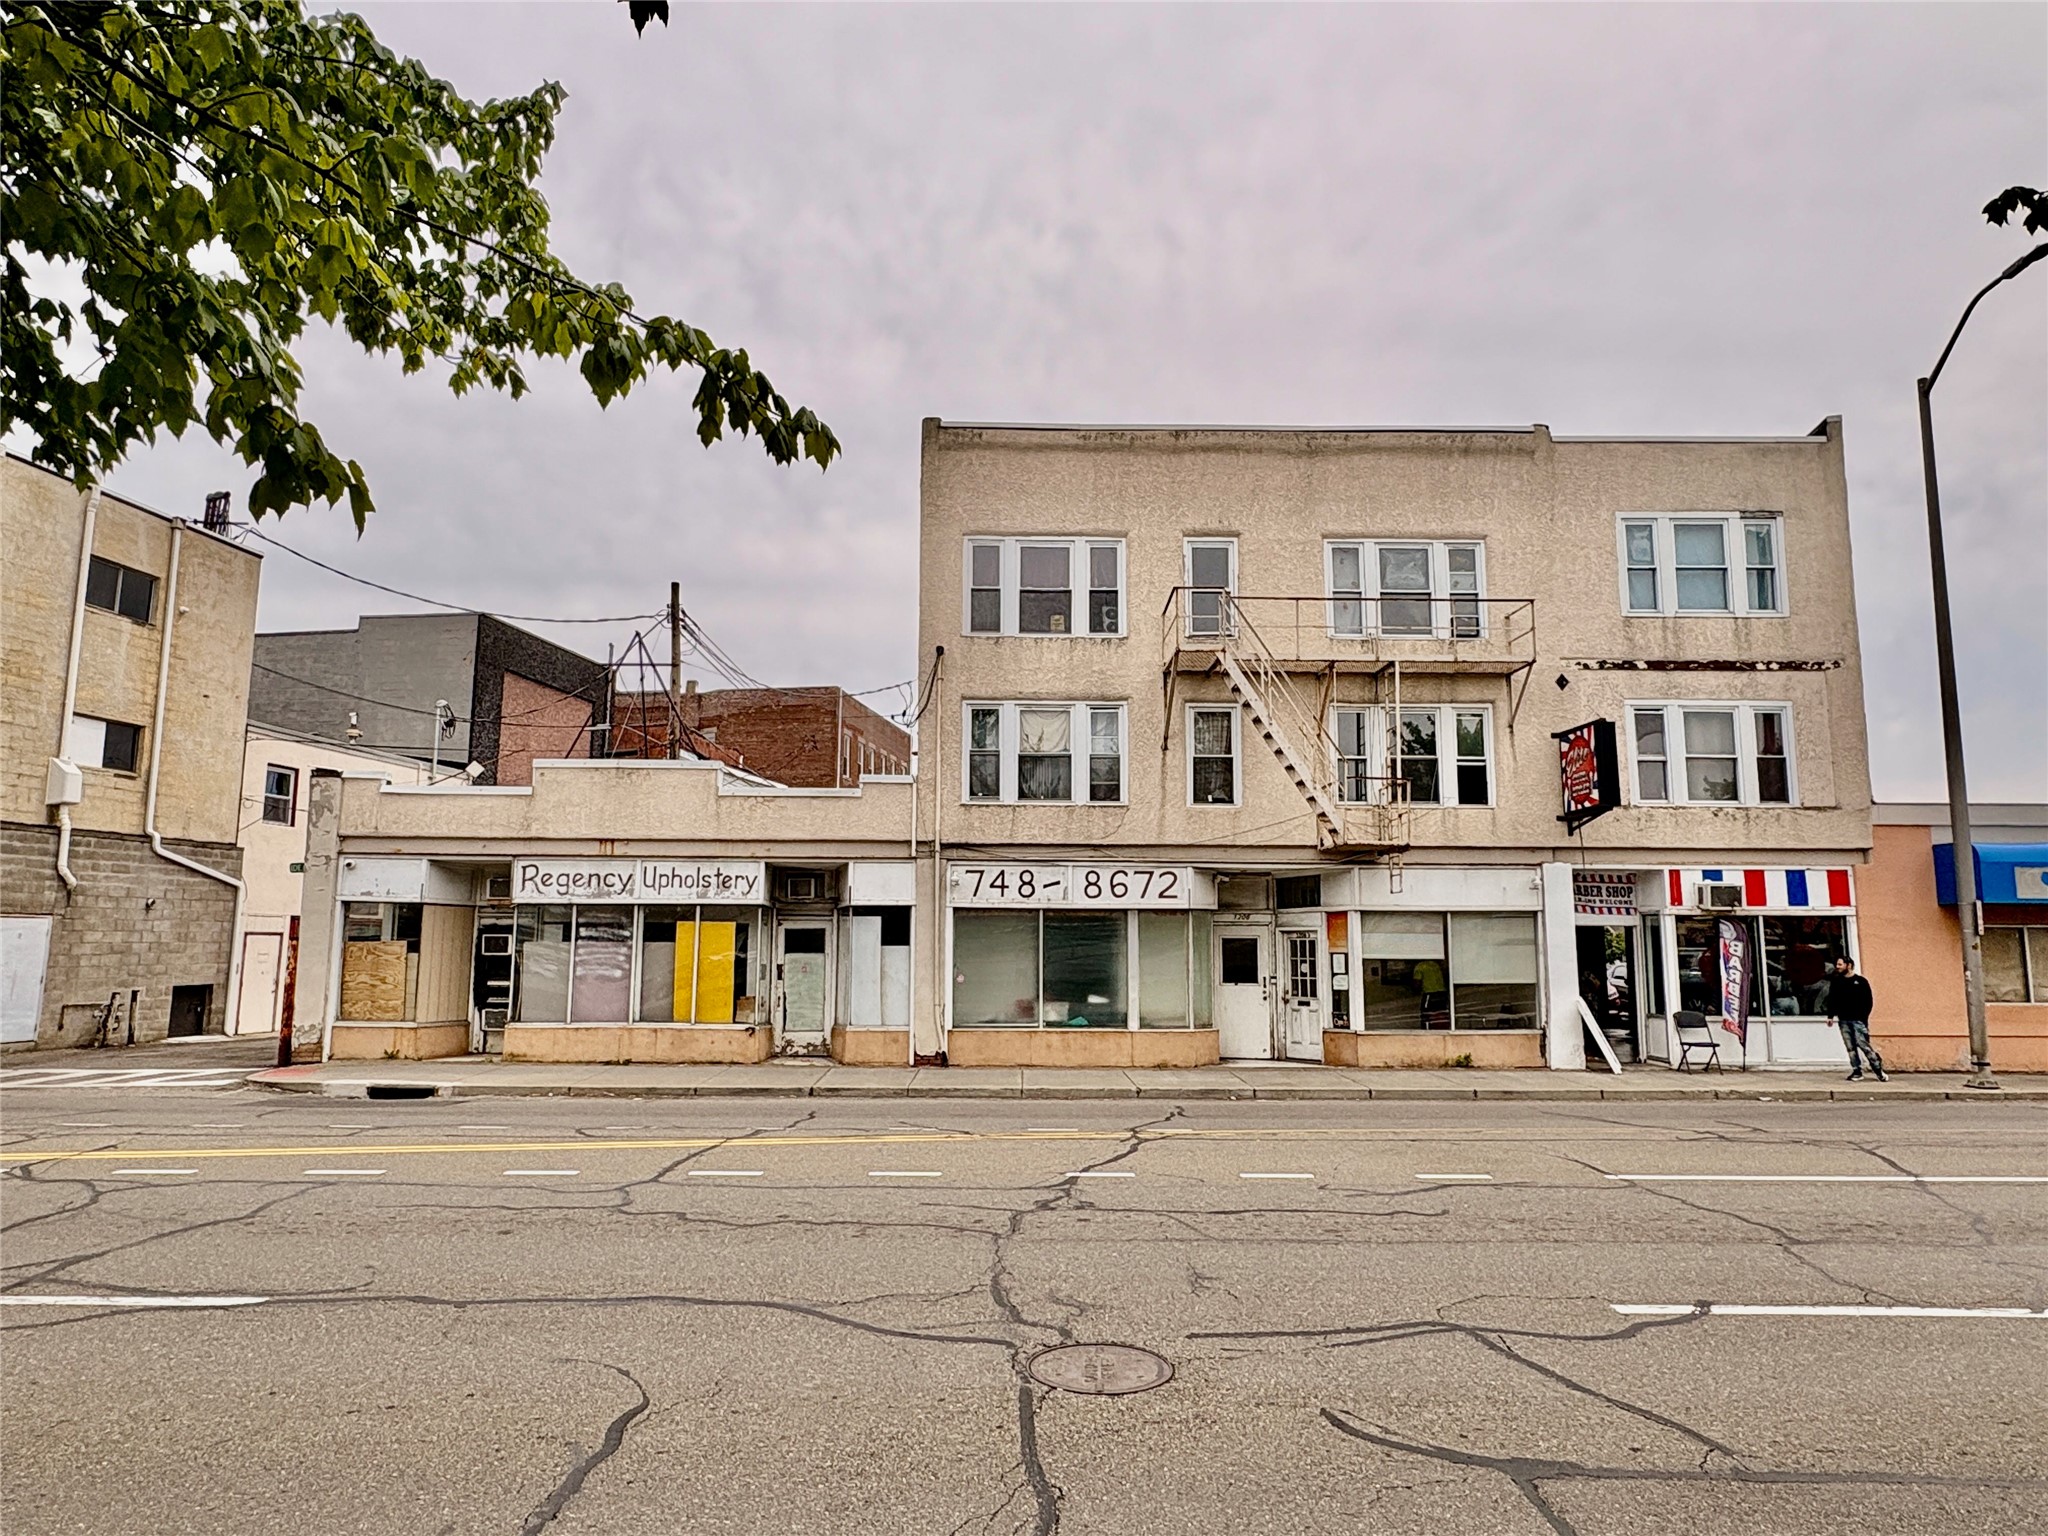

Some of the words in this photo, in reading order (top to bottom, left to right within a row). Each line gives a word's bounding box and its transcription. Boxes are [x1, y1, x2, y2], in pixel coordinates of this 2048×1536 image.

[520, 863, 634, 896] Regency
[642, 865, 760, 896] Upholstery
[964, 869, 1062, 898] 748-
[1083, 869, 1179, 900] 8672
[1605, 886, 1633, 898] SHOP
